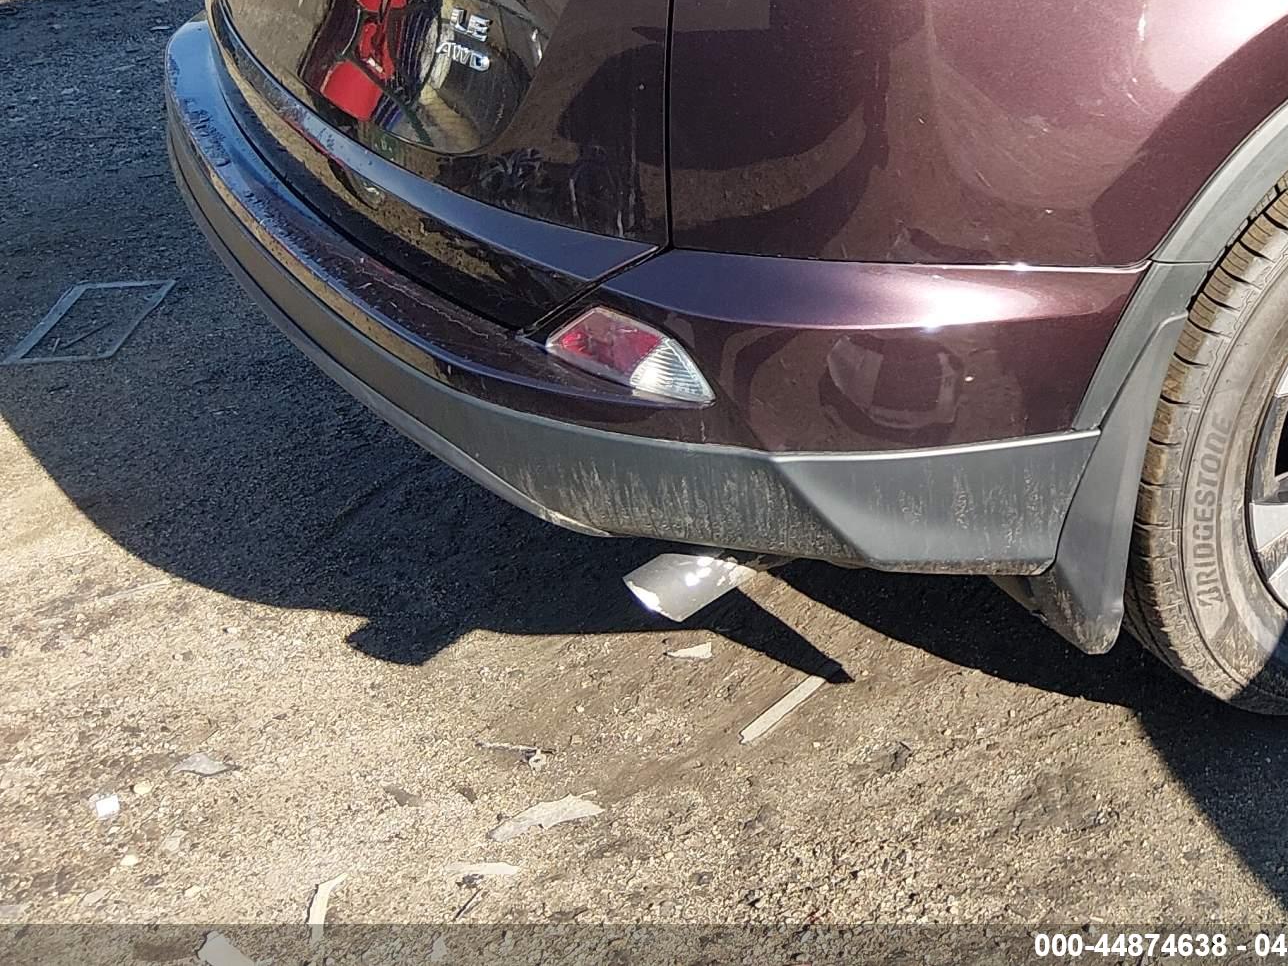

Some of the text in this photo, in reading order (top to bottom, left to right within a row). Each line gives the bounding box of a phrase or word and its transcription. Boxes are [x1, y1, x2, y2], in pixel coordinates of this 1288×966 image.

[451, 6, 491, 42] LE
[436, 41, 490, 71] AWD
[1192, 413, 1233, 608] BRIDGESTONE
